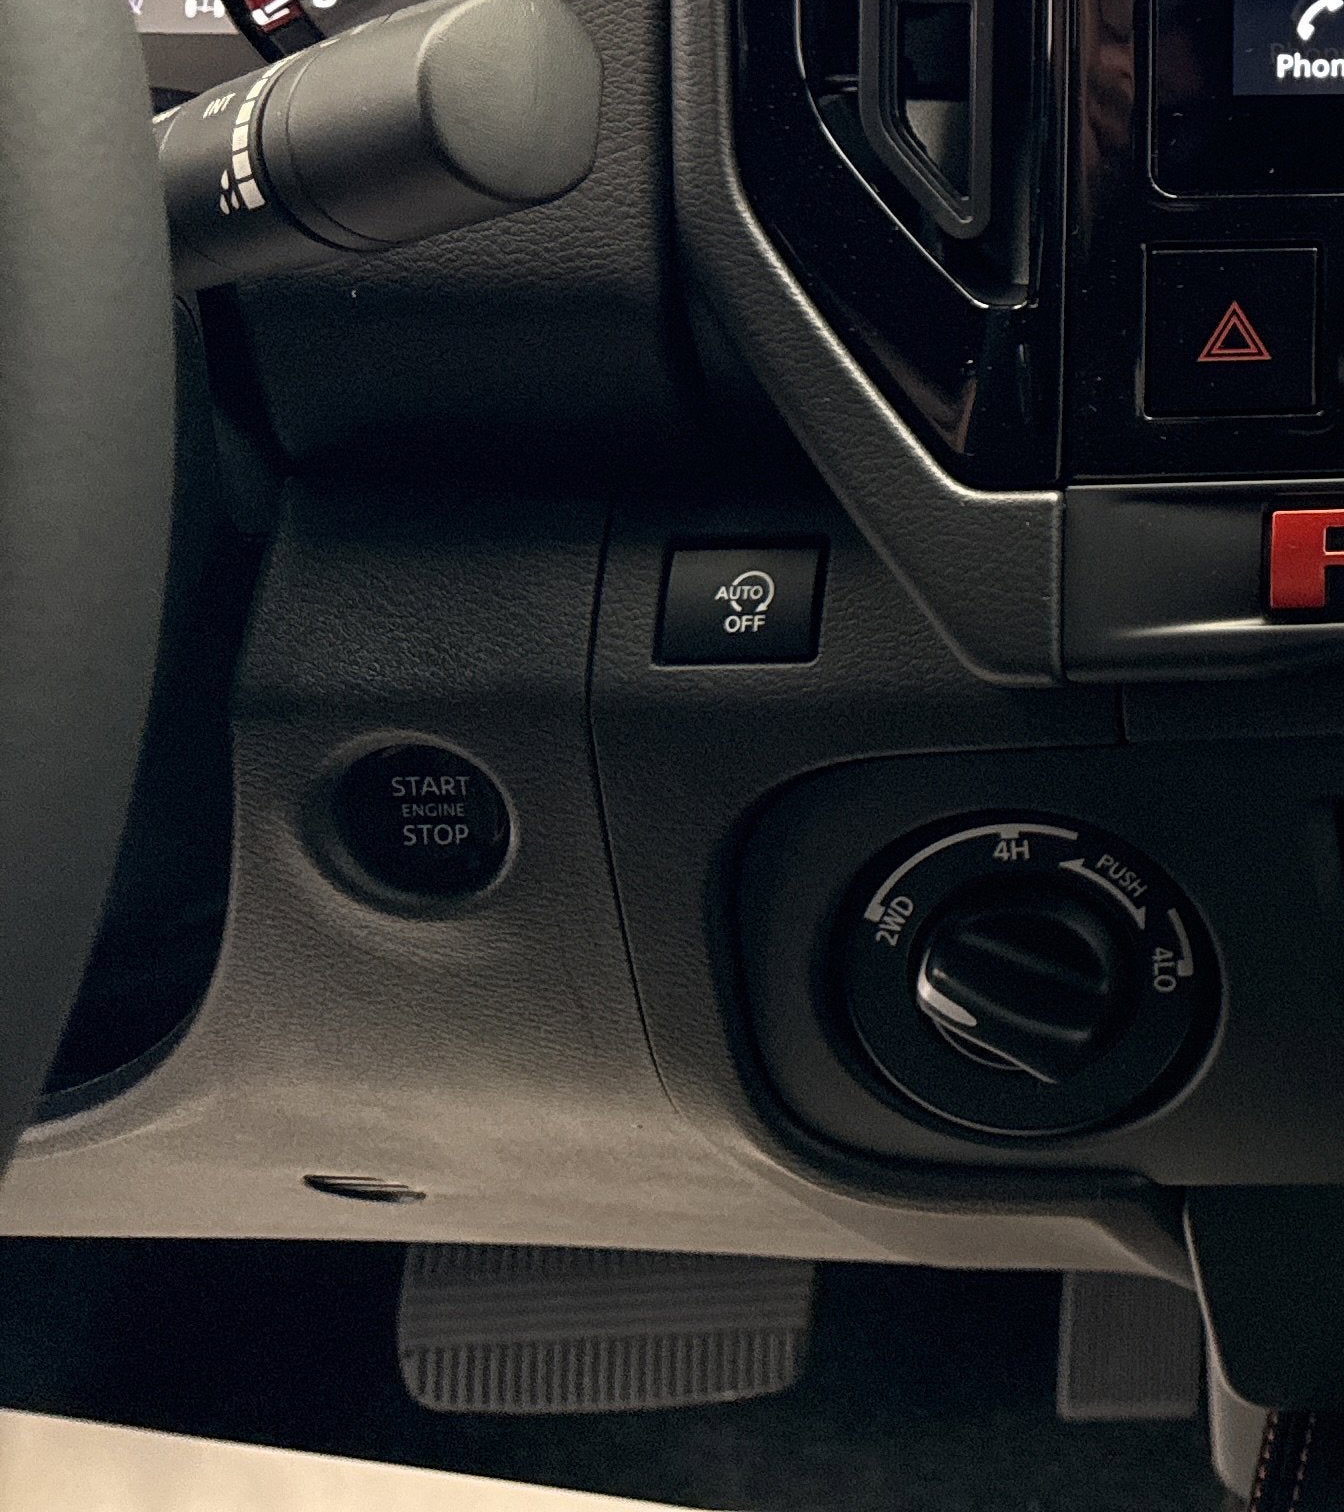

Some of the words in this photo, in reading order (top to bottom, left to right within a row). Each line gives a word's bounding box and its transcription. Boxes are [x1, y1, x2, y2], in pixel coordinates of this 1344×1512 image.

[714, 583, 765, 602] AUTO
[722, 614, 767, 634] OFF
[390, 775, 471, 798] START
[401, 802, 466, 818] ENGINE
[402, 824, 470, 848] STOP
[992, 838, 1031, 863] 4H
[1095, 853, 1149, 899] PUSH
[875, 894, 916, 948] 2WD
[1151, 946, 1180, 995] 4LO
